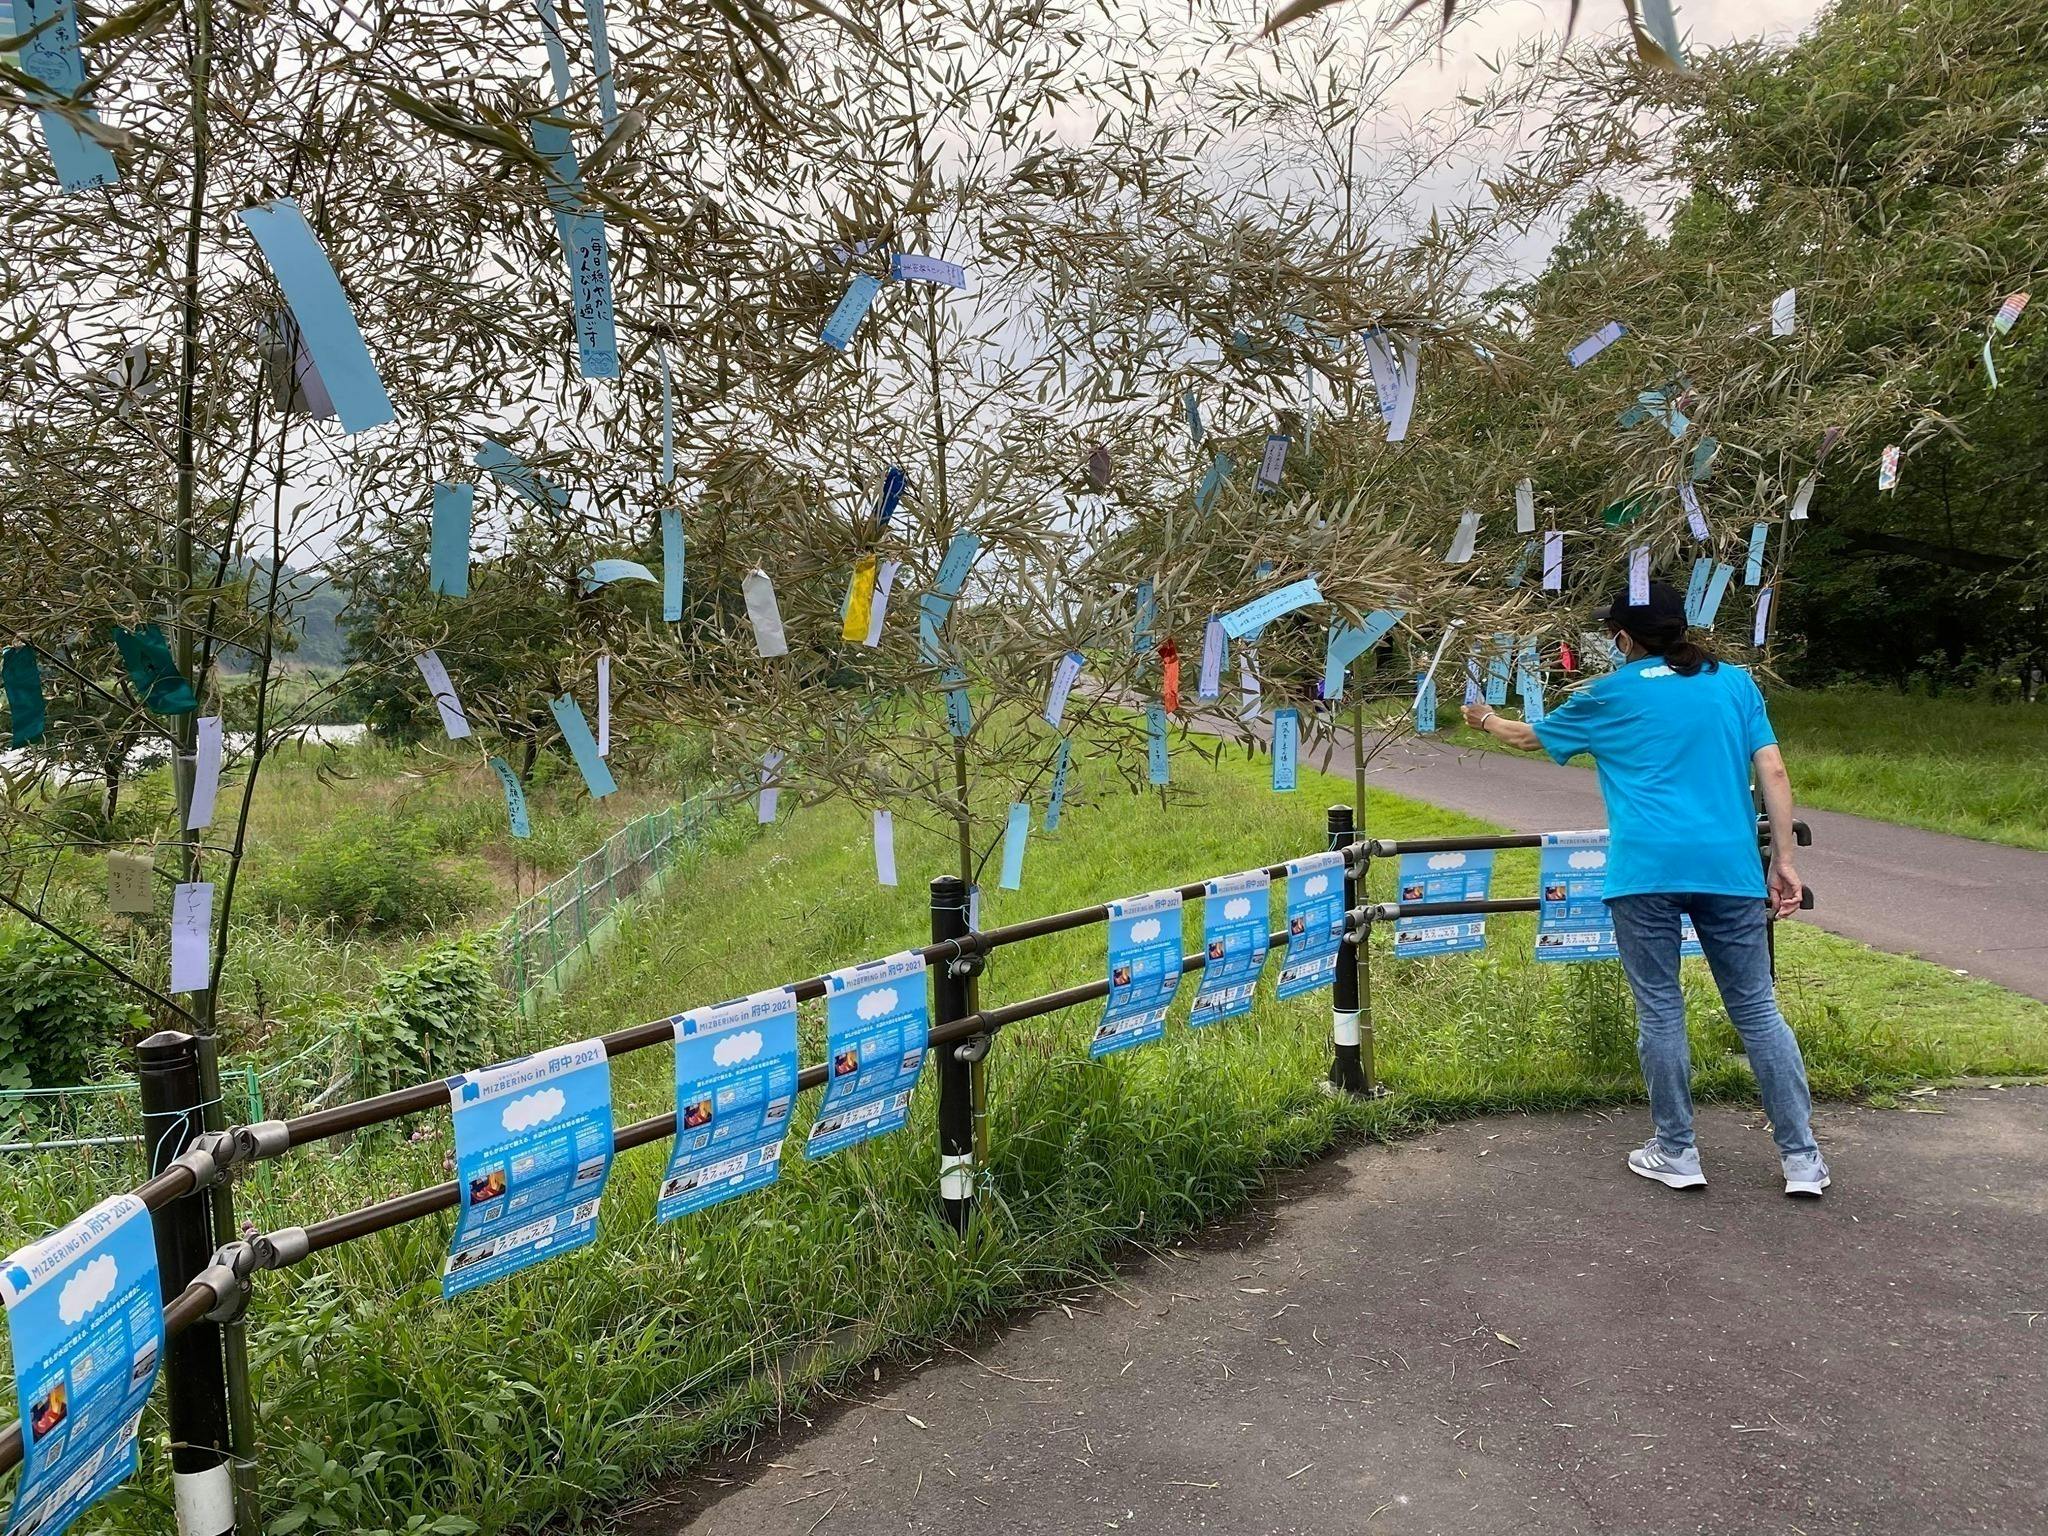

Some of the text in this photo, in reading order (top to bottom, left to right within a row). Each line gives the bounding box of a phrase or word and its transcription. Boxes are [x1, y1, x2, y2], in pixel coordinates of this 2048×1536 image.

[579, 246, 598, 348] のんびり過ごす
[590, 237, 609, 320] 毎日穏やかに
[887, 963, 904, 977] 府中
[905, 960, 921, 972] 2021
[699, 999, 792, 1031] MIZBERING in 府中 2021
[482, 1073, 534, 1096] MIZBERING
[535, 1067, 546, 1079] in
[548, 1055, 573, 1073] 府中
[574, 1048, 600, 1066] 2021
[31, 1238, 80, 1280] MIZBERING
[84, 1211, 113, 1236] 府中
[110, 1199, 138, 1220] 2021
